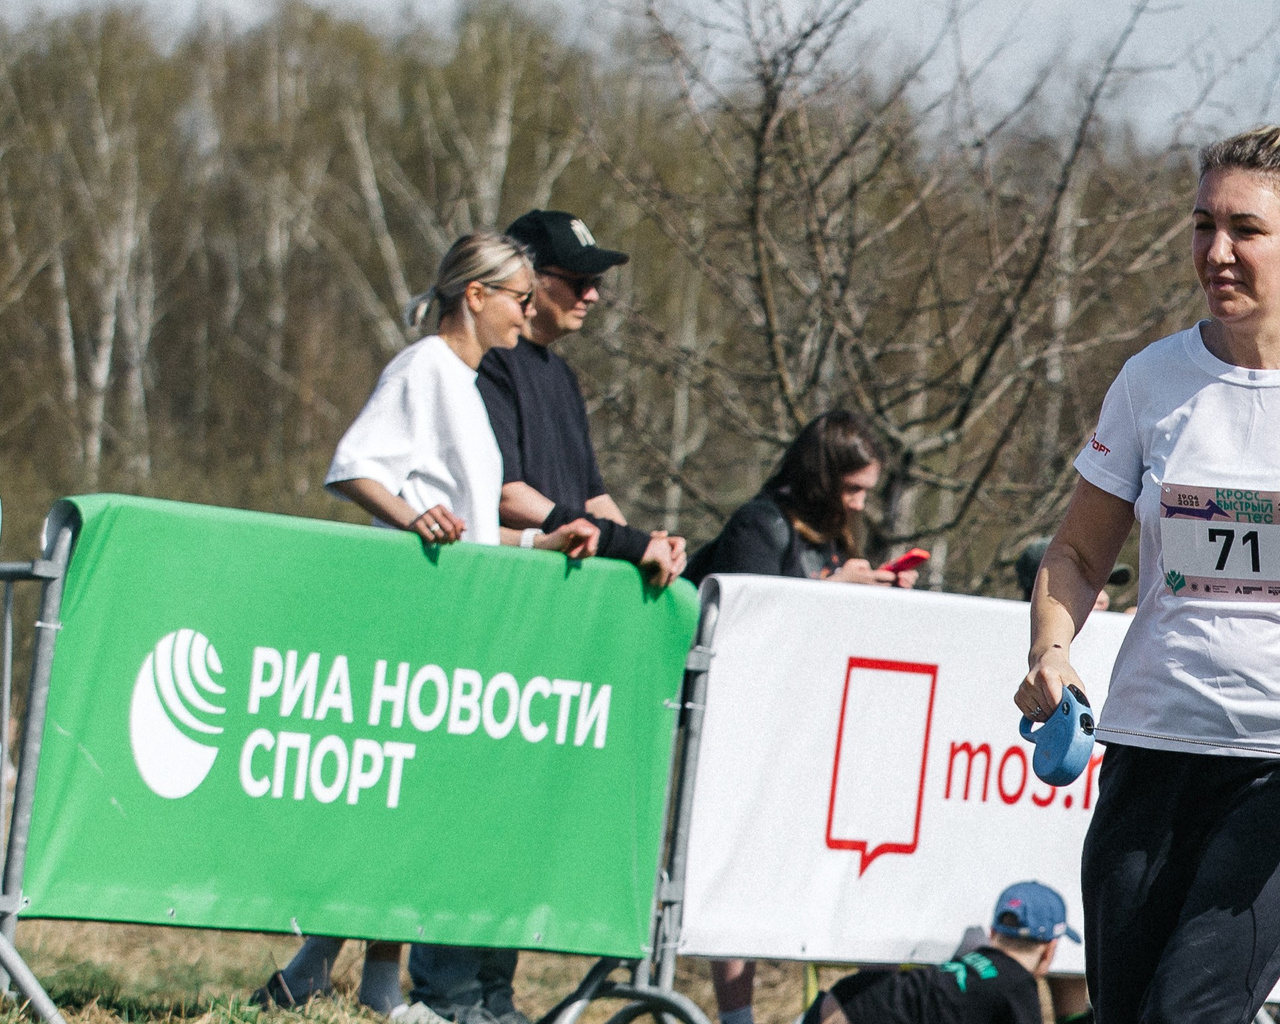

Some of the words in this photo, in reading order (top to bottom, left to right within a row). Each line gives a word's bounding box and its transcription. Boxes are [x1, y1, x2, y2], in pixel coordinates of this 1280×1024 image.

[1215, 488, 1260, 501] КРОСС
[1208, 528, 1261, 573] 71
[247, 646, 354, 724] РИА
[367, 659, 613, 749] НОВОСТИ
[239, 728, 417, 809] СПОРТ
